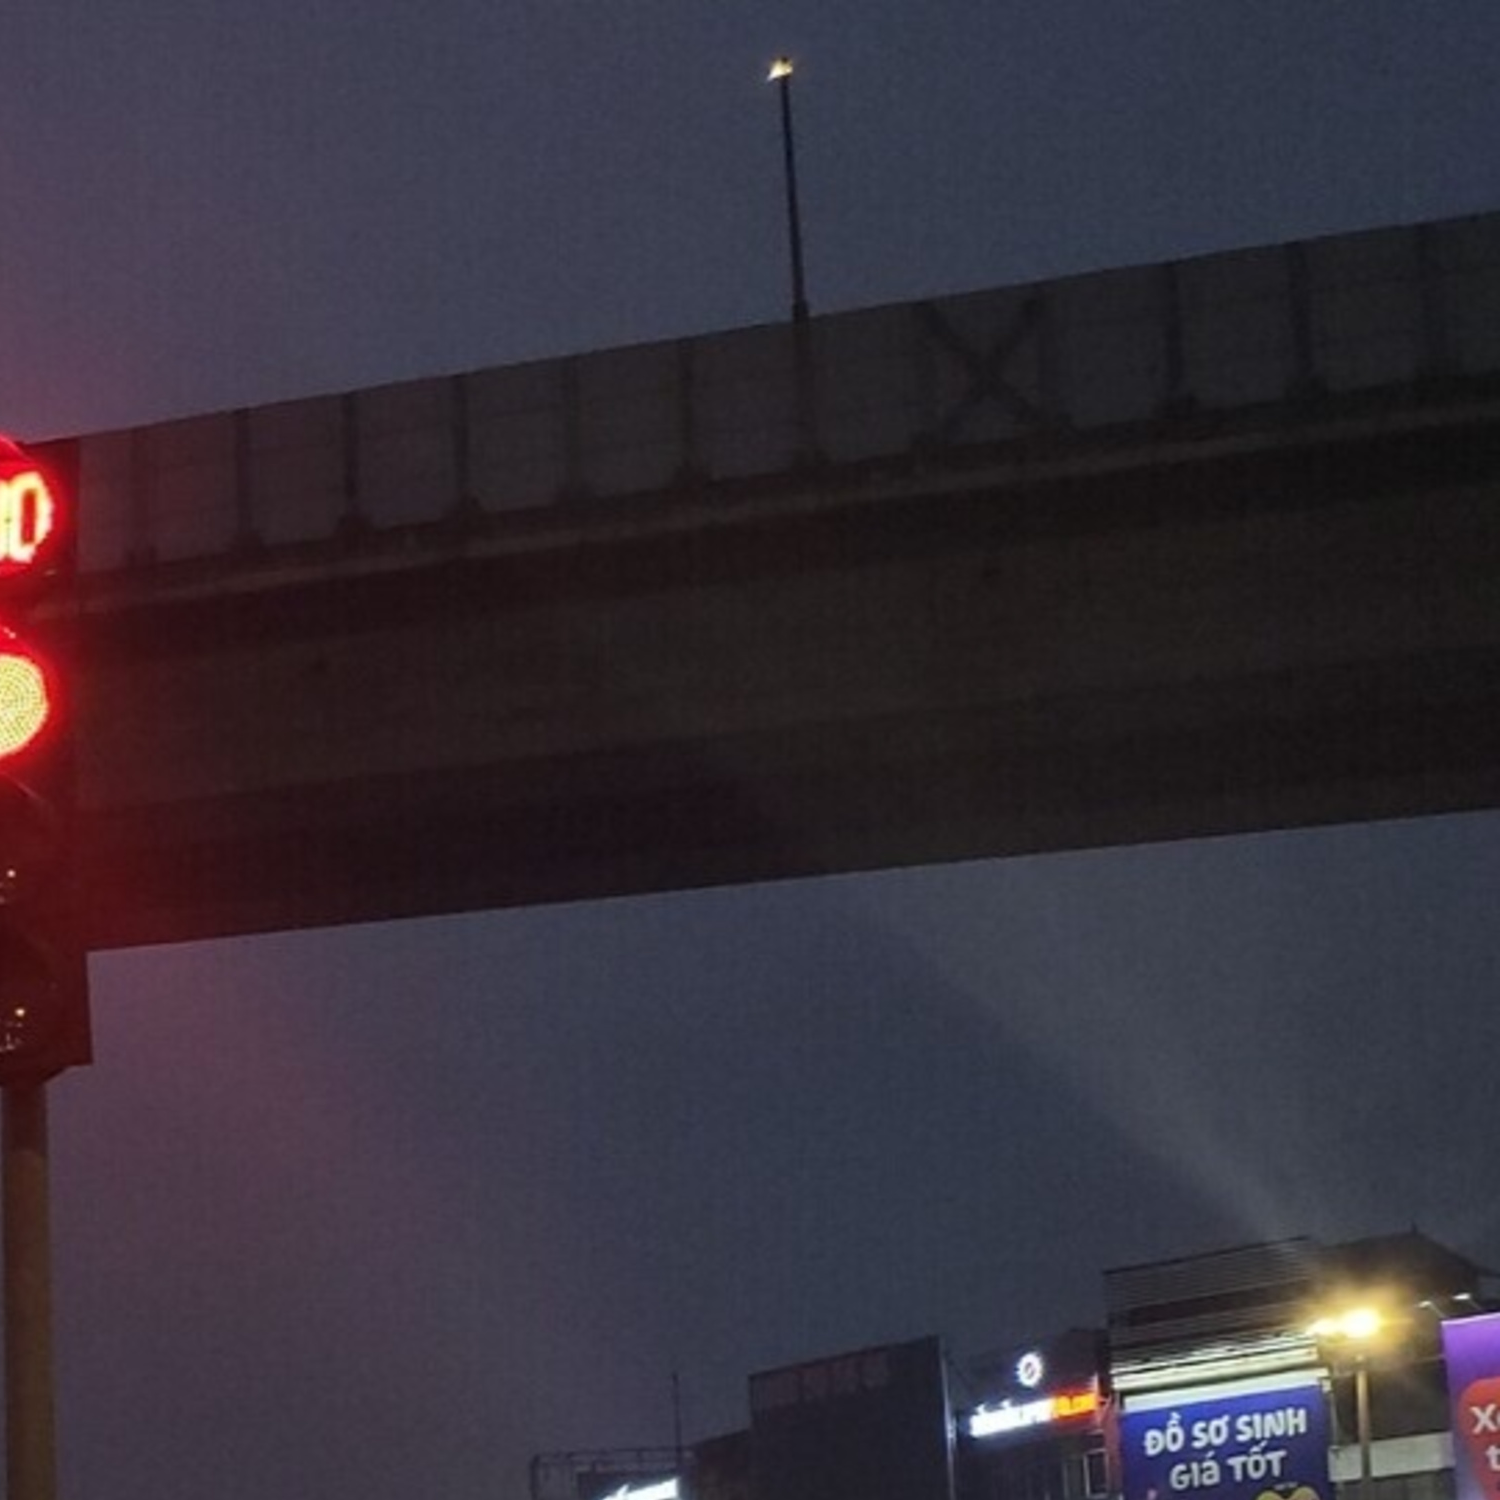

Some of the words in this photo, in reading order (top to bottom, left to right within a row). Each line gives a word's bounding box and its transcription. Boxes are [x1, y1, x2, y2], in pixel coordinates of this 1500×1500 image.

[1144, 1413, 1184, 1457] ĐỒ
[1192, 1415, 1230, 1449] SƠ
[1236, 1407, 1307, 1442] SINH
[1226, 1441, 1287, 1483] TỐT
